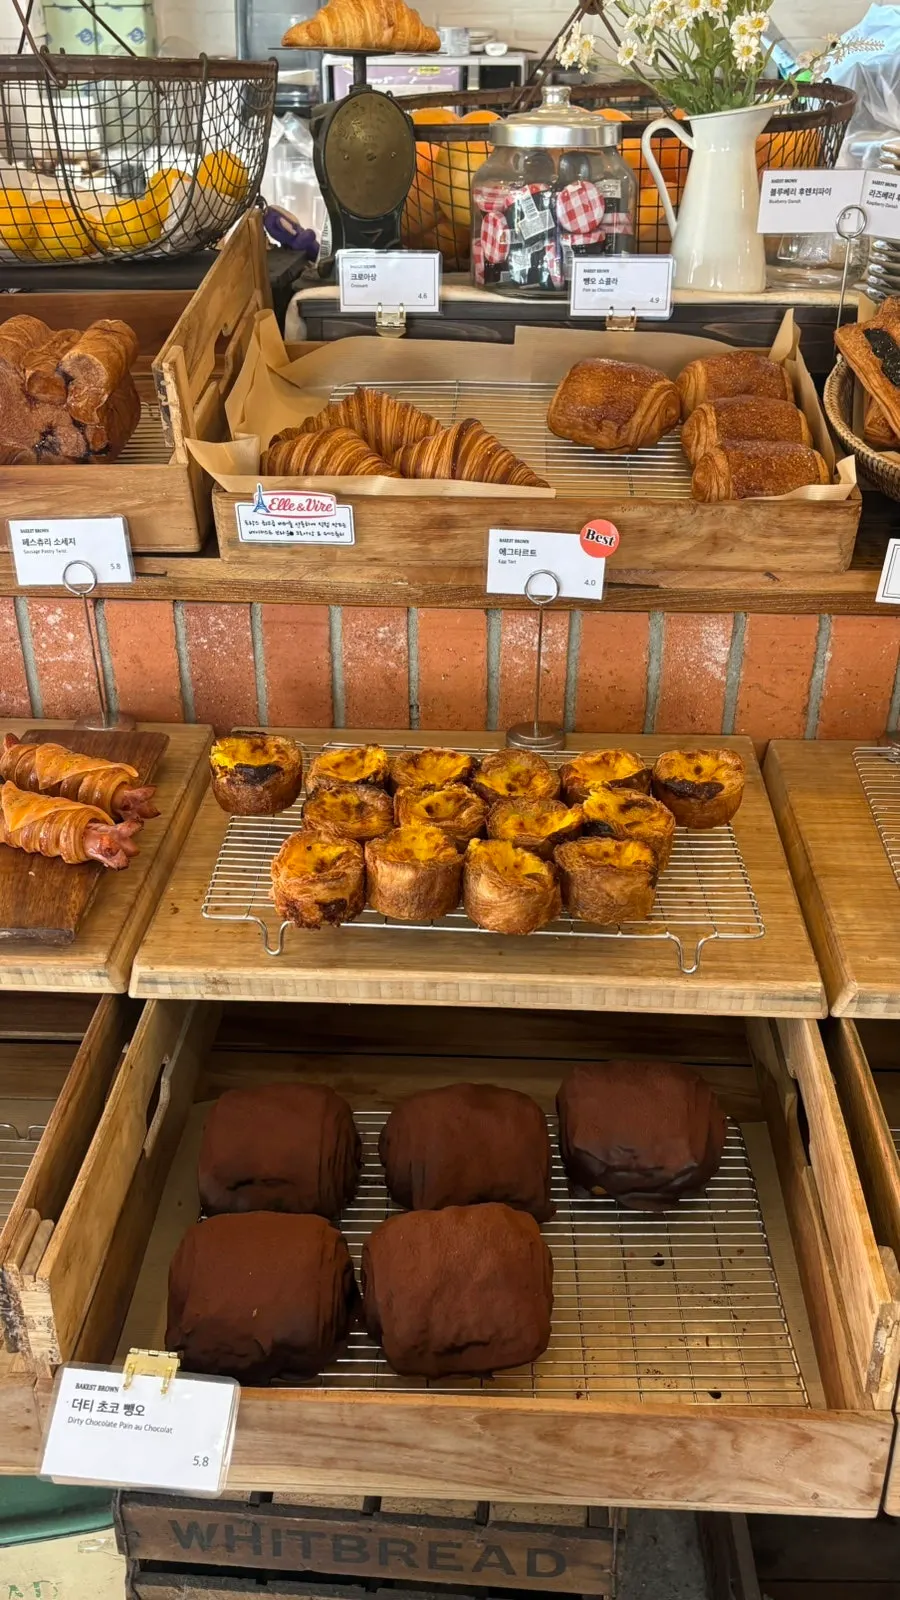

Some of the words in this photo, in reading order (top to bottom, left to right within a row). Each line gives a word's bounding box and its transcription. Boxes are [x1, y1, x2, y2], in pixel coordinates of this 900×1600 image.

[769, 187, 797, 197] 블루베리
[798, 187, 833, 197] 후렌치파이
[868, 189, 895, 202] 라즈베리
[350, 272, 377, 282] 크로아상
[53, 537, 77, 547] 소세지
[585, 528, 616, 547] Best
[498, 547, 538, 558] 에그타르트
[583, 578, 597, 588] 4.0
[75, 1382, 97, 1392] BAKEST
[97, 1384, 120, 1393] BROWN
[71, 1398, 95, 1414] 더티
[96, 1400, 120, 1415] 초코
[122, 1402, 146, 1418] 뺑오
[67, 1416, 85, 1426] Dirty
[84, 1417, 118, 1429] Chocolate
[118, 1420, 134, 1430] Pain
[133, 1423, 143, 1431] au
[143, 1423, 173, 1434] Chocolat
[167, 1518, 568, 1579] WHITBREAD
